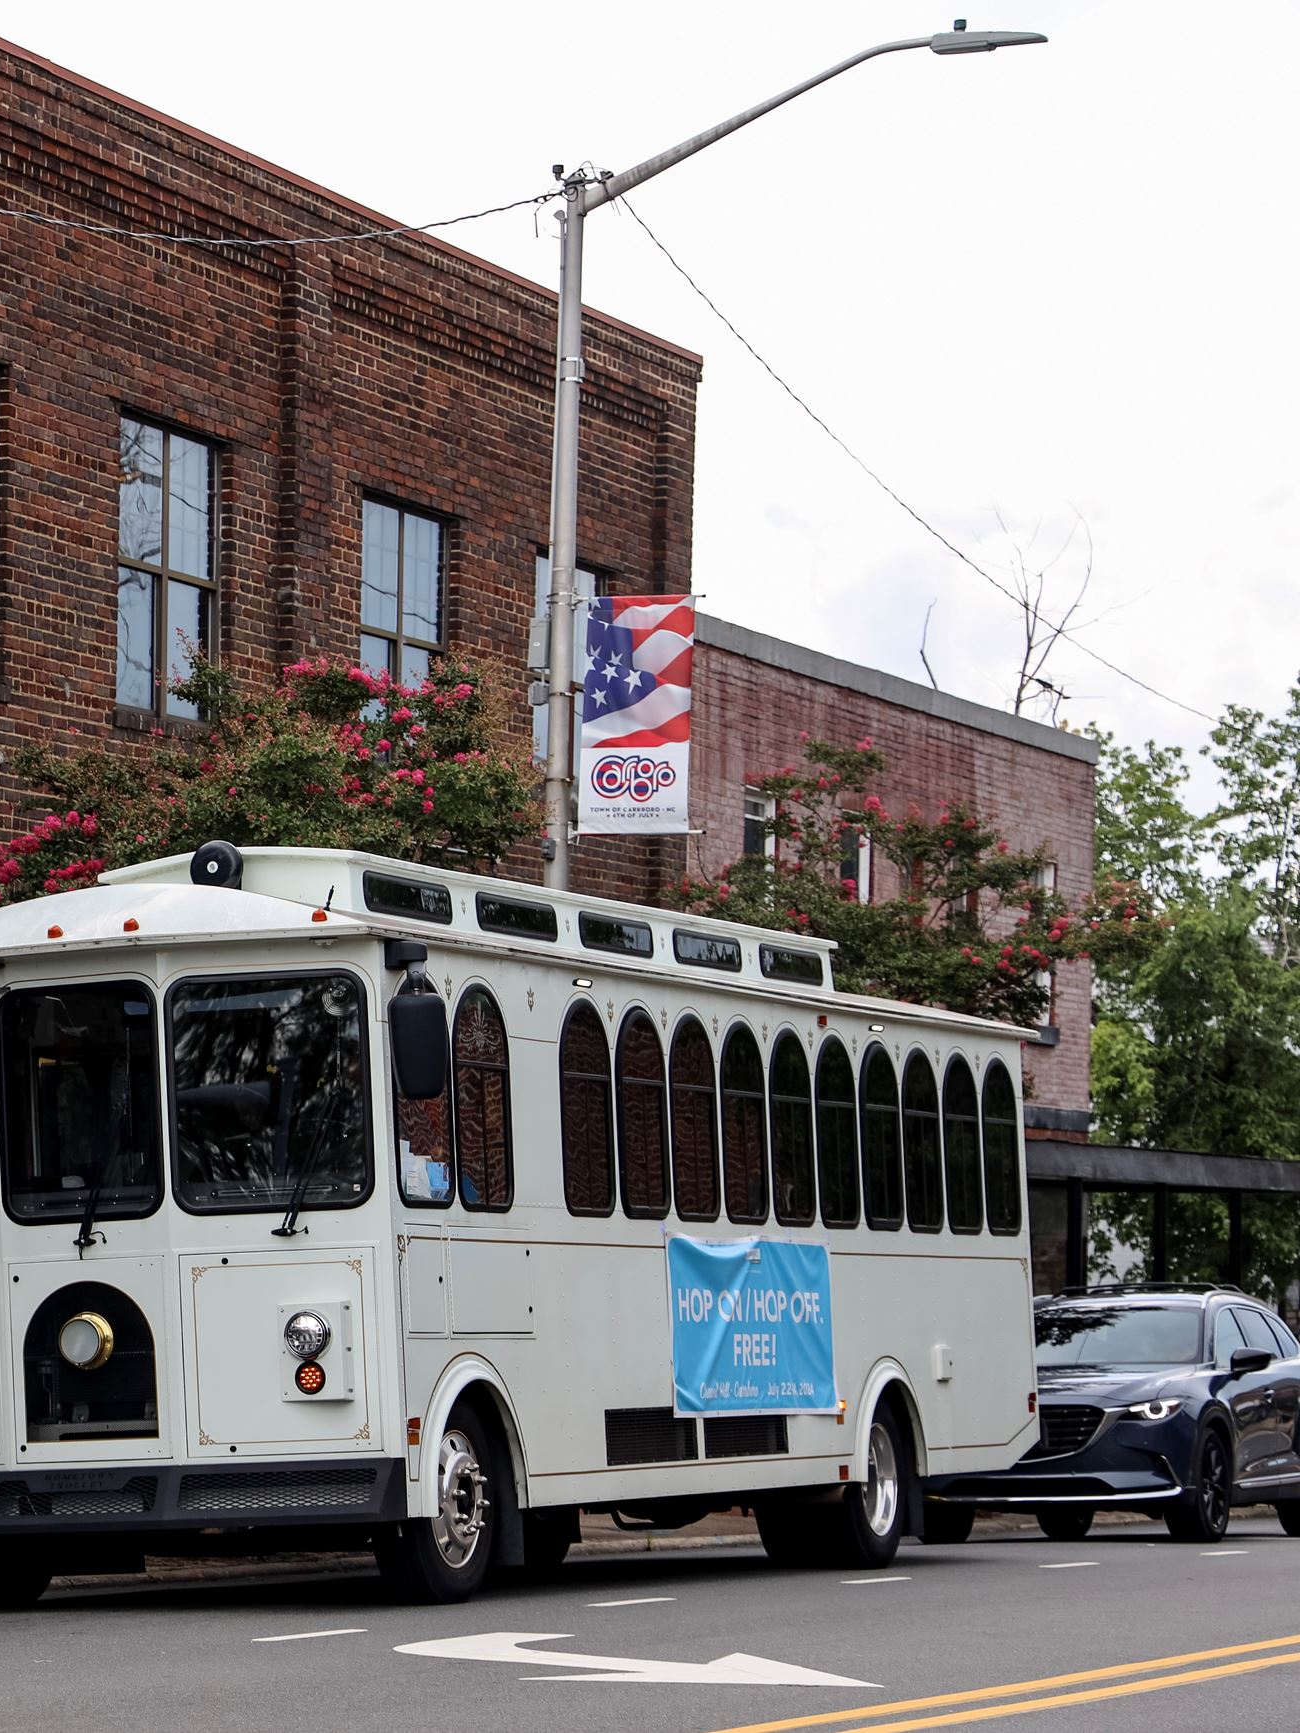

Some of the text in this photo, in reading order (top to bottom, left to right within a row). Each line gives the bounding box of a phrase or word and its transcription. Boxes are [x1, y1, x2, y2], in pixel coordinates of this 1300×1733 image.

[677, 1288, 713, 1323] HOP
[718, 1289, 742, 1323] ON
[754, 1289, 787, 1322] HOP
[733, 1333, 777, 1367] FREE!
